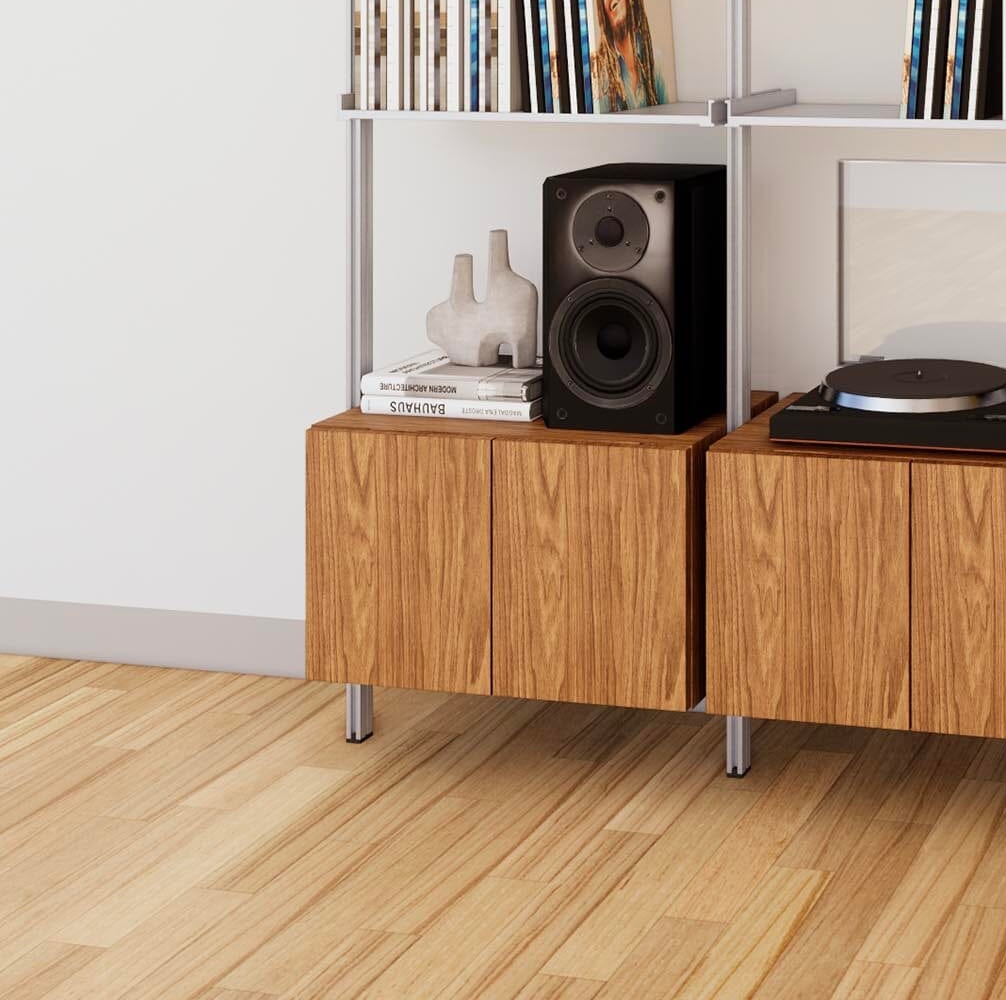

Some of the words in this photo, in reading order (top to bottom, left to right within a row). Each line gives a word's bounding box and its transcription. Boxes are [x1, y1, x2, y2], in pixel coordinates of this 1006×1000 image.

[380, 382, 428, 392] ARCHITECTURE
[428, 385, 456, 393] MODERN
[390, 401, 446, 415] BAUHAUS
[485, 408, 522, 417] MAGDALENA
